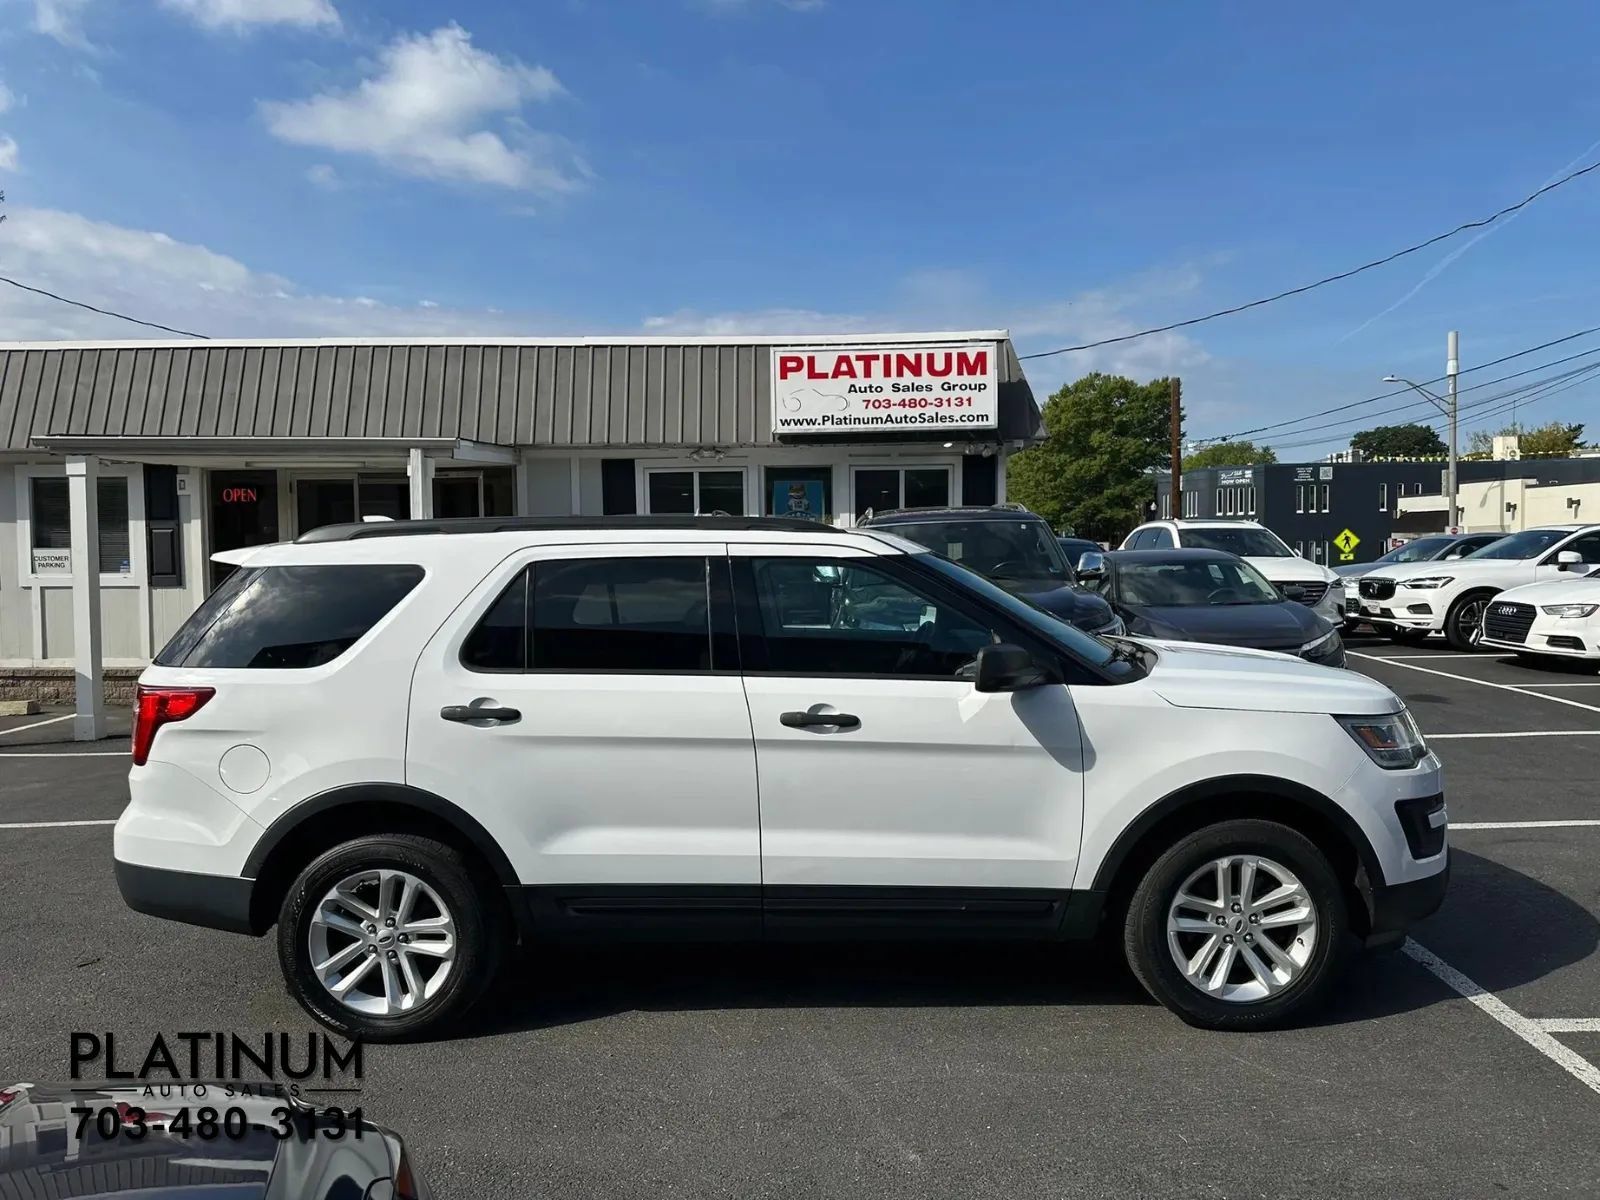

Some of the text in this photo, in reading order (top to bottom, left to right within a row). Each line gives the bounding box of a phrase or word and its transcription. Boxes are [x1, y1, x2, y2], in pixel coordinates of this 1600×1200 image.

[779, 351, 988, 380] PLATINUM
[847, 381, 987, 394] Auto Sales Group
[862, 396, 973, 410] 703-480-3131
[779, 412, 989, 427] www.PlatinumAutoSales.com
[222, 488, 257, 502] OPEN
